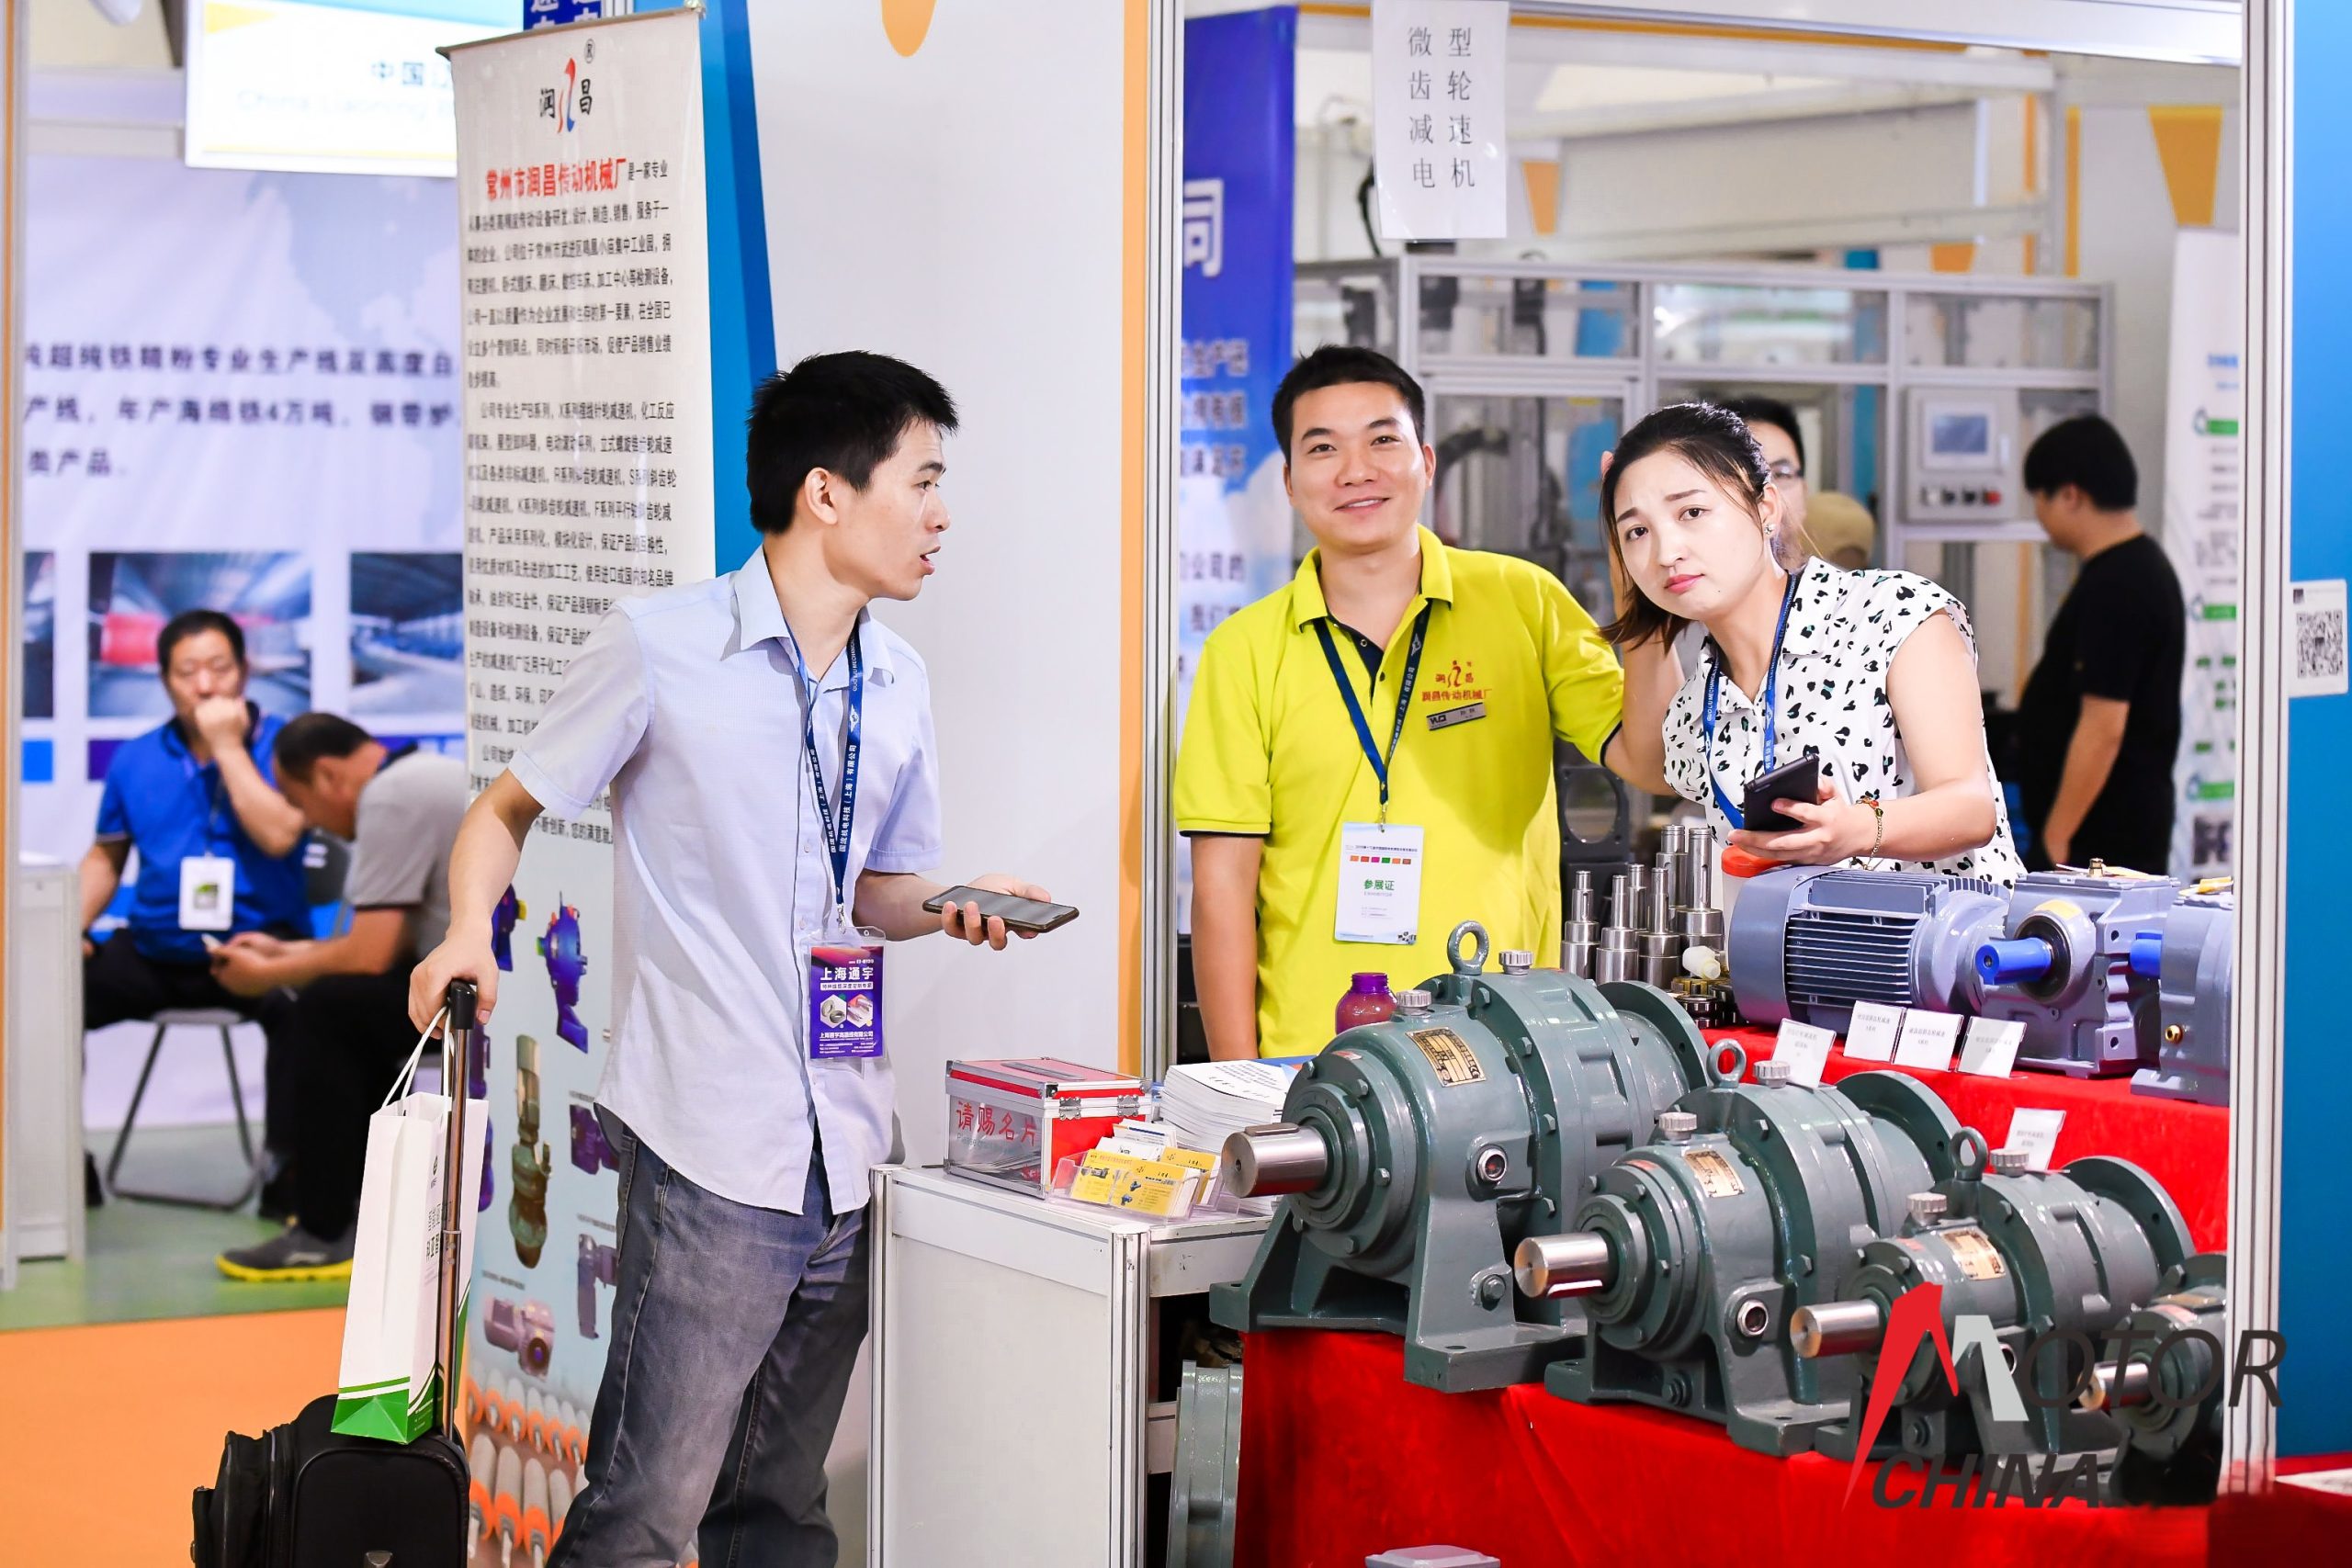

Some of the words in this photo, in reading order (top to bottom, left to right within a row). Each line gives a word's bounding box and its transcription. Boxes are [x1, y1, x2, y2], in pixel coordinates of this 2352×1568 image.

[1408, 26, 1472, 58] 微型
[1408, 69, 1473, 102] 齿轮
[1408, 113, 1473, 146] 减速
[1412, 156, 1476, 189] 电机
[1421, 688, 1493, 702] 润昌传动机械厂
[1363, 878, 1396, 891] 参展证
[820, 966, 874, 981] 上海通宇
[956, 1100, 1037, 1147] 请赐名片
